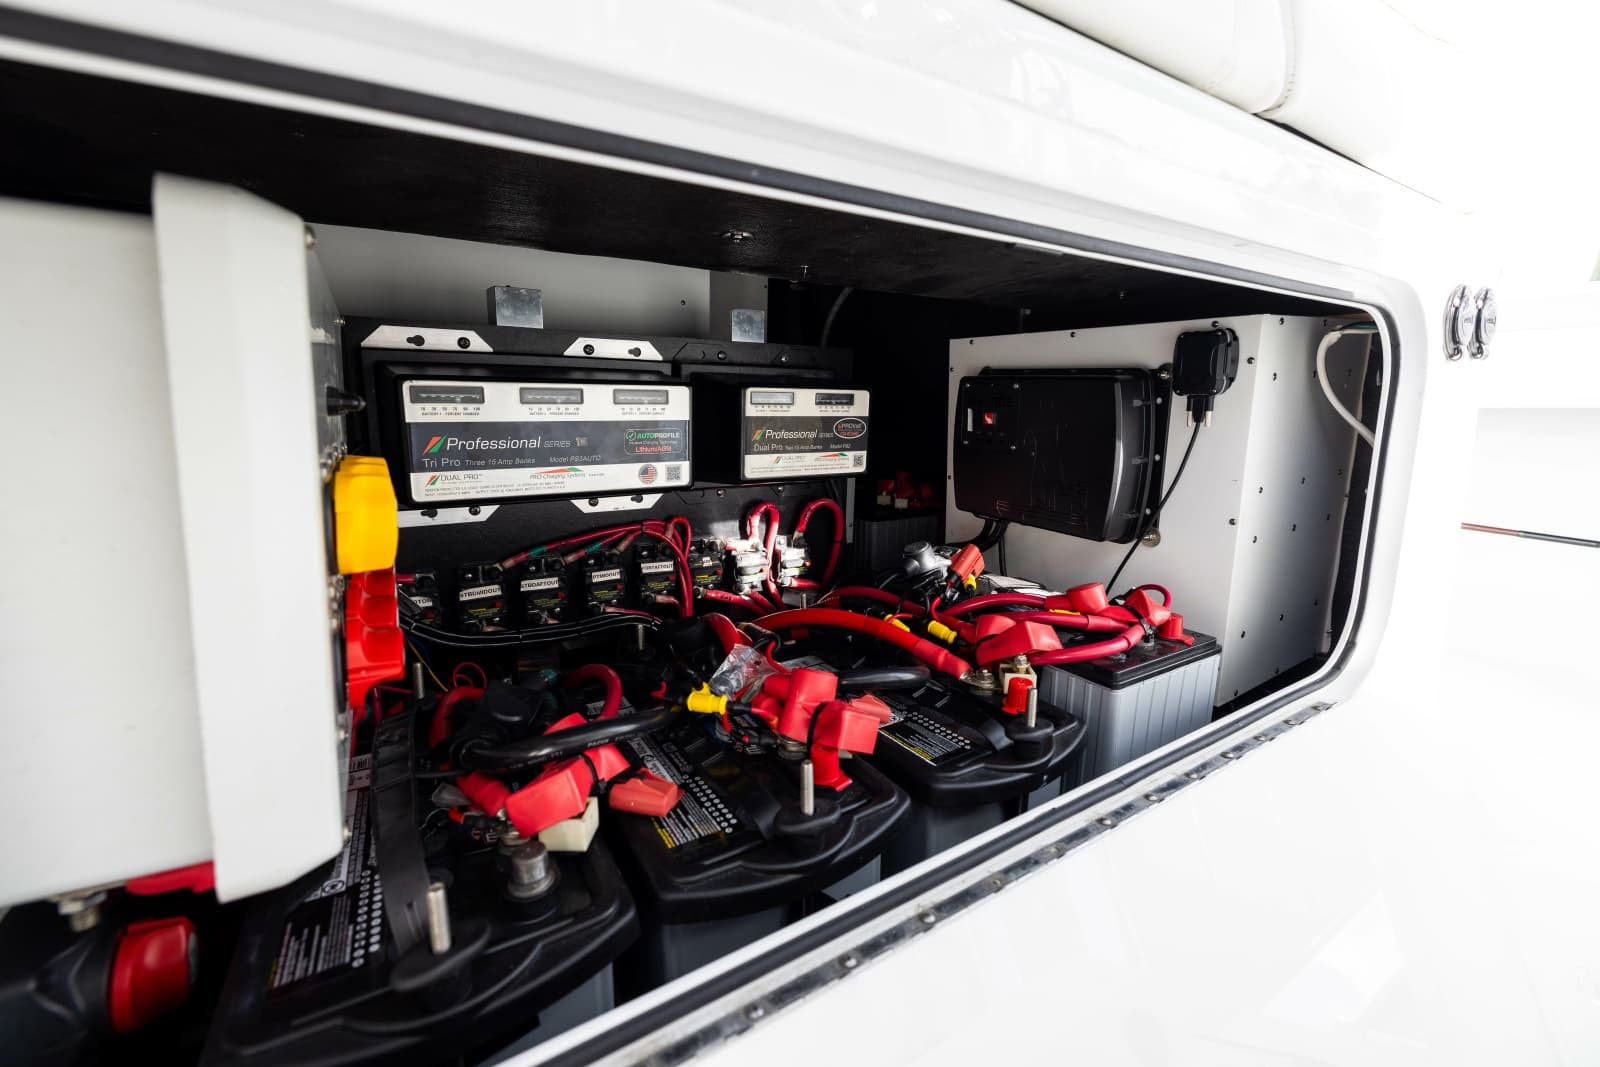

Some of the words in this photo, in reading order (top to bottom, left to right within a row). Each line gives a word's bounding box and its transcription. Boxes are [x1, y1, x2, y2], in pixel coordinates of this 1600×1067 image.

[765, 429, 818, 439] Professional
[446, 436, 541, 451] Professional
[543, 440, 572, 448] SERIES
[754, 443, 769, 451] Dual
[422, 458, 438, 468] Tri
[441, 457, 461, 468] Pro
[549, 455, 569, 463] Model
